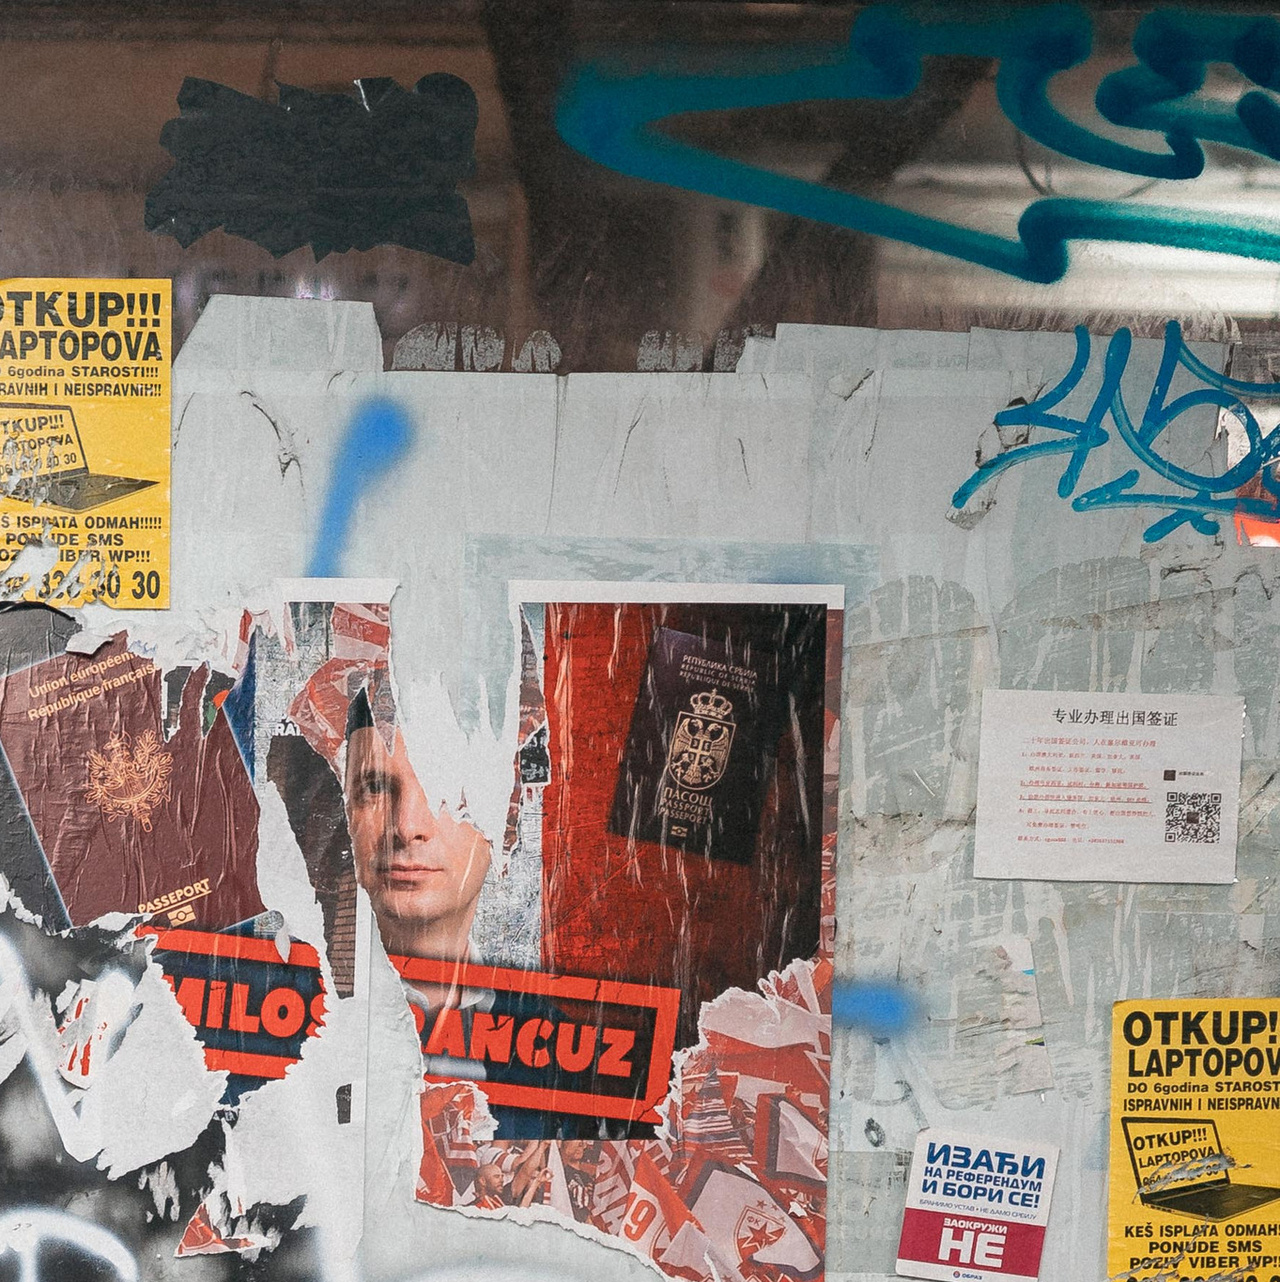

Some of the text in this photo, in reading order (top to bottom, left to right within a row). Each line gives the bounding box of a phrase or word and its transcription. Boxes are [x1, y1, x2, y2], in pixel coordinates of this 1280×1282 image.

[8, 365, 65, 379] 6godina
[72, 366, 158, 378] STAROSTI!!!
[54, 383, 58, 396] I
[64, 383, 162, 397] NEISPRAVNIH!!
[85, 516, 162, 529] ODMAH!!!!!
[6, 533, 124, 546] PONDE SMS
[58, 550, 151, 563] IBER WP!!!
[132, 570, 161, 600] 30
[682, 655, 727, 672] РЕПУБЛИКА
[29, 652, 137, 699] Union européen
[28, 685, 101, 721] République
[1052, 708, 1178, 726] 专业办理出国签证
[664, 786, 712, 807] ПАСОШ
[663, 798, 710, 817] PASSPORT
[138, 878, 210, 914] PASSEPORT
[1128, 1081, 1280, 1095] DO 6godina STAROST
[1123, 1098, 1192, 1111] ISPRAVNIH
[1198, 1098, 1202, 1111] I
[1133, 1127, 1207, 1151] OTKUP!!!
[927, 1142, 1045, 1179] ИЗАЂИ
[1139, 1146, 1215, 1169] LAPTOPOVA
[924, 1166, 1042, 1192] НА РЕФЕРЕНДУМ
[922, 1179, 1040, 1208] И БОРИ СЕ!
[919, 1199, 953, 1210] БРАНИМО
[954, 1204, 975, 1212] УСТАВ
[990, 1209, 1011, 1217] ДАМО
[943, 1218, 1008, 1234] ЗАОКРУЖИ
[1125, 1222, 1153, 1237] KEŠ
[1160, 1225, 1218, 1237] ISPLATA
[938, 1228, 1006, 1268] НЕ
[1149, 1240, 1262, 1253] PONUDE SMS
[1189, 1256, 1239, 1269] VIBER
[962, 1273, 983, 1281] ОБРАЗ
